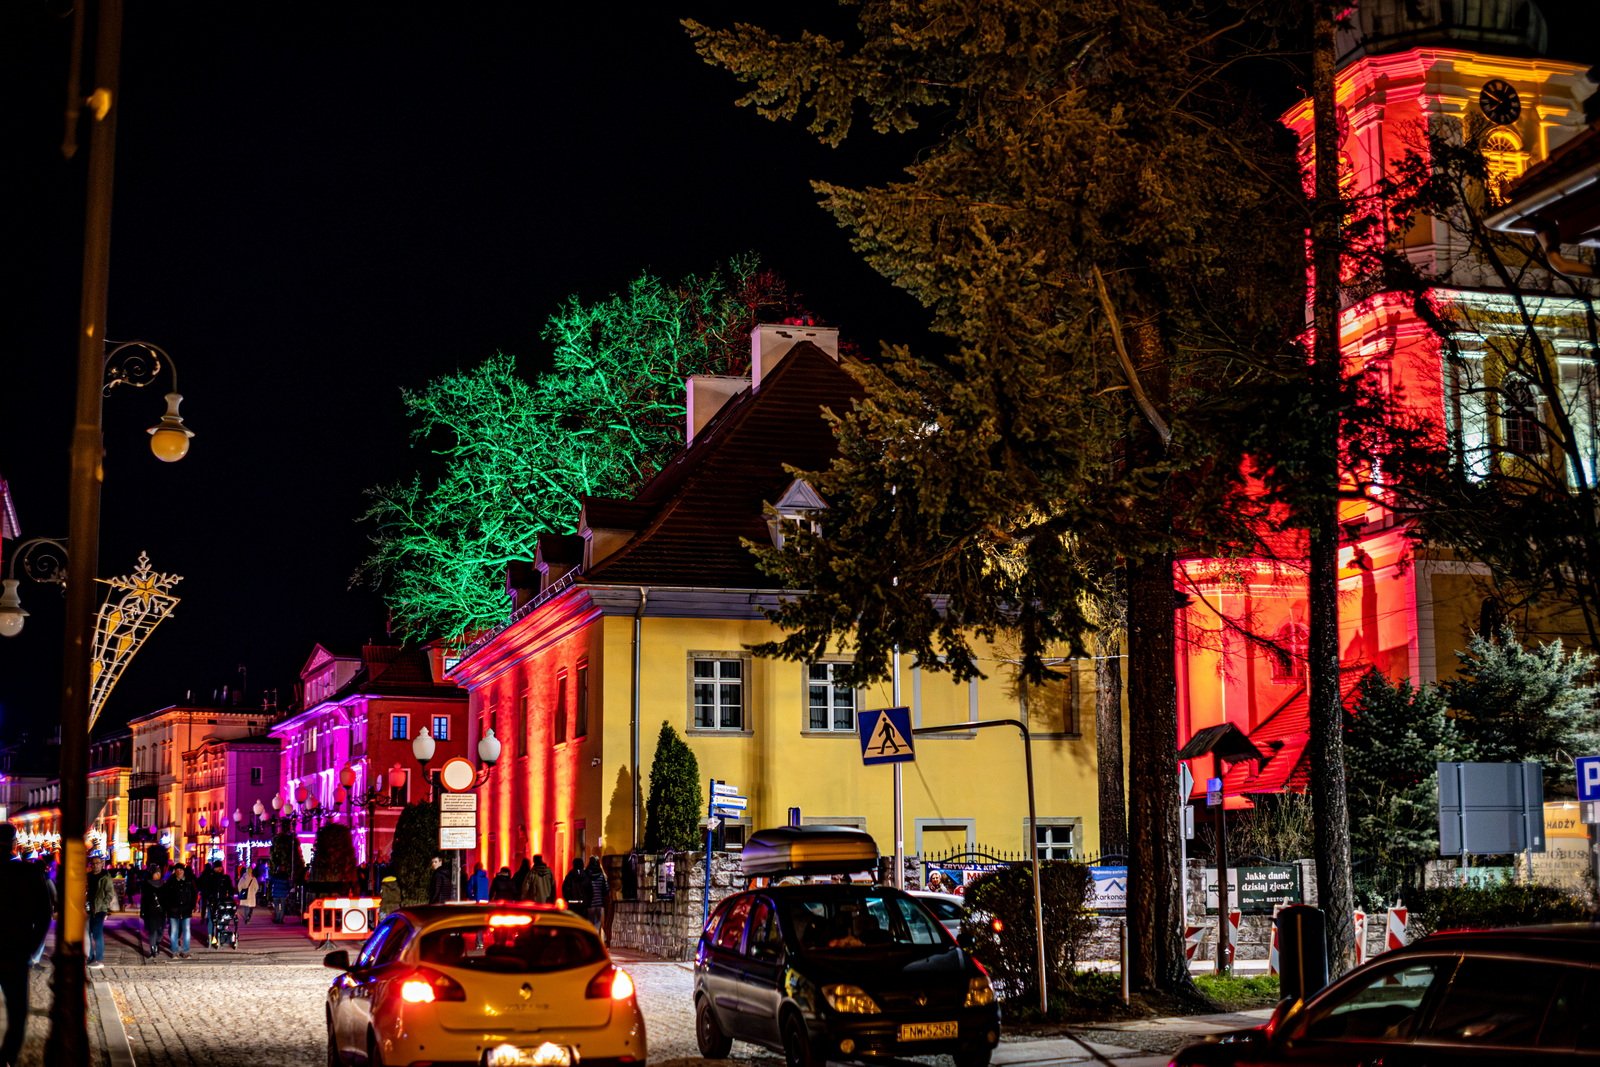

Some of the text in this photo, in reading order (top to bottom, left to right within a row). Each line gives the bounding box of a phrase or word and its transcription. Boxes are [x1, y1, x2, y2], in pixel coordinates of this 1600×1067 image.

[1583, 761, 1600, 796] P
[1245, 871, 1290, 880] Jakie danie
[1241, 882, 1268, 893] dzisiaj
[1269, 881, 1294, 893] zjesz?
